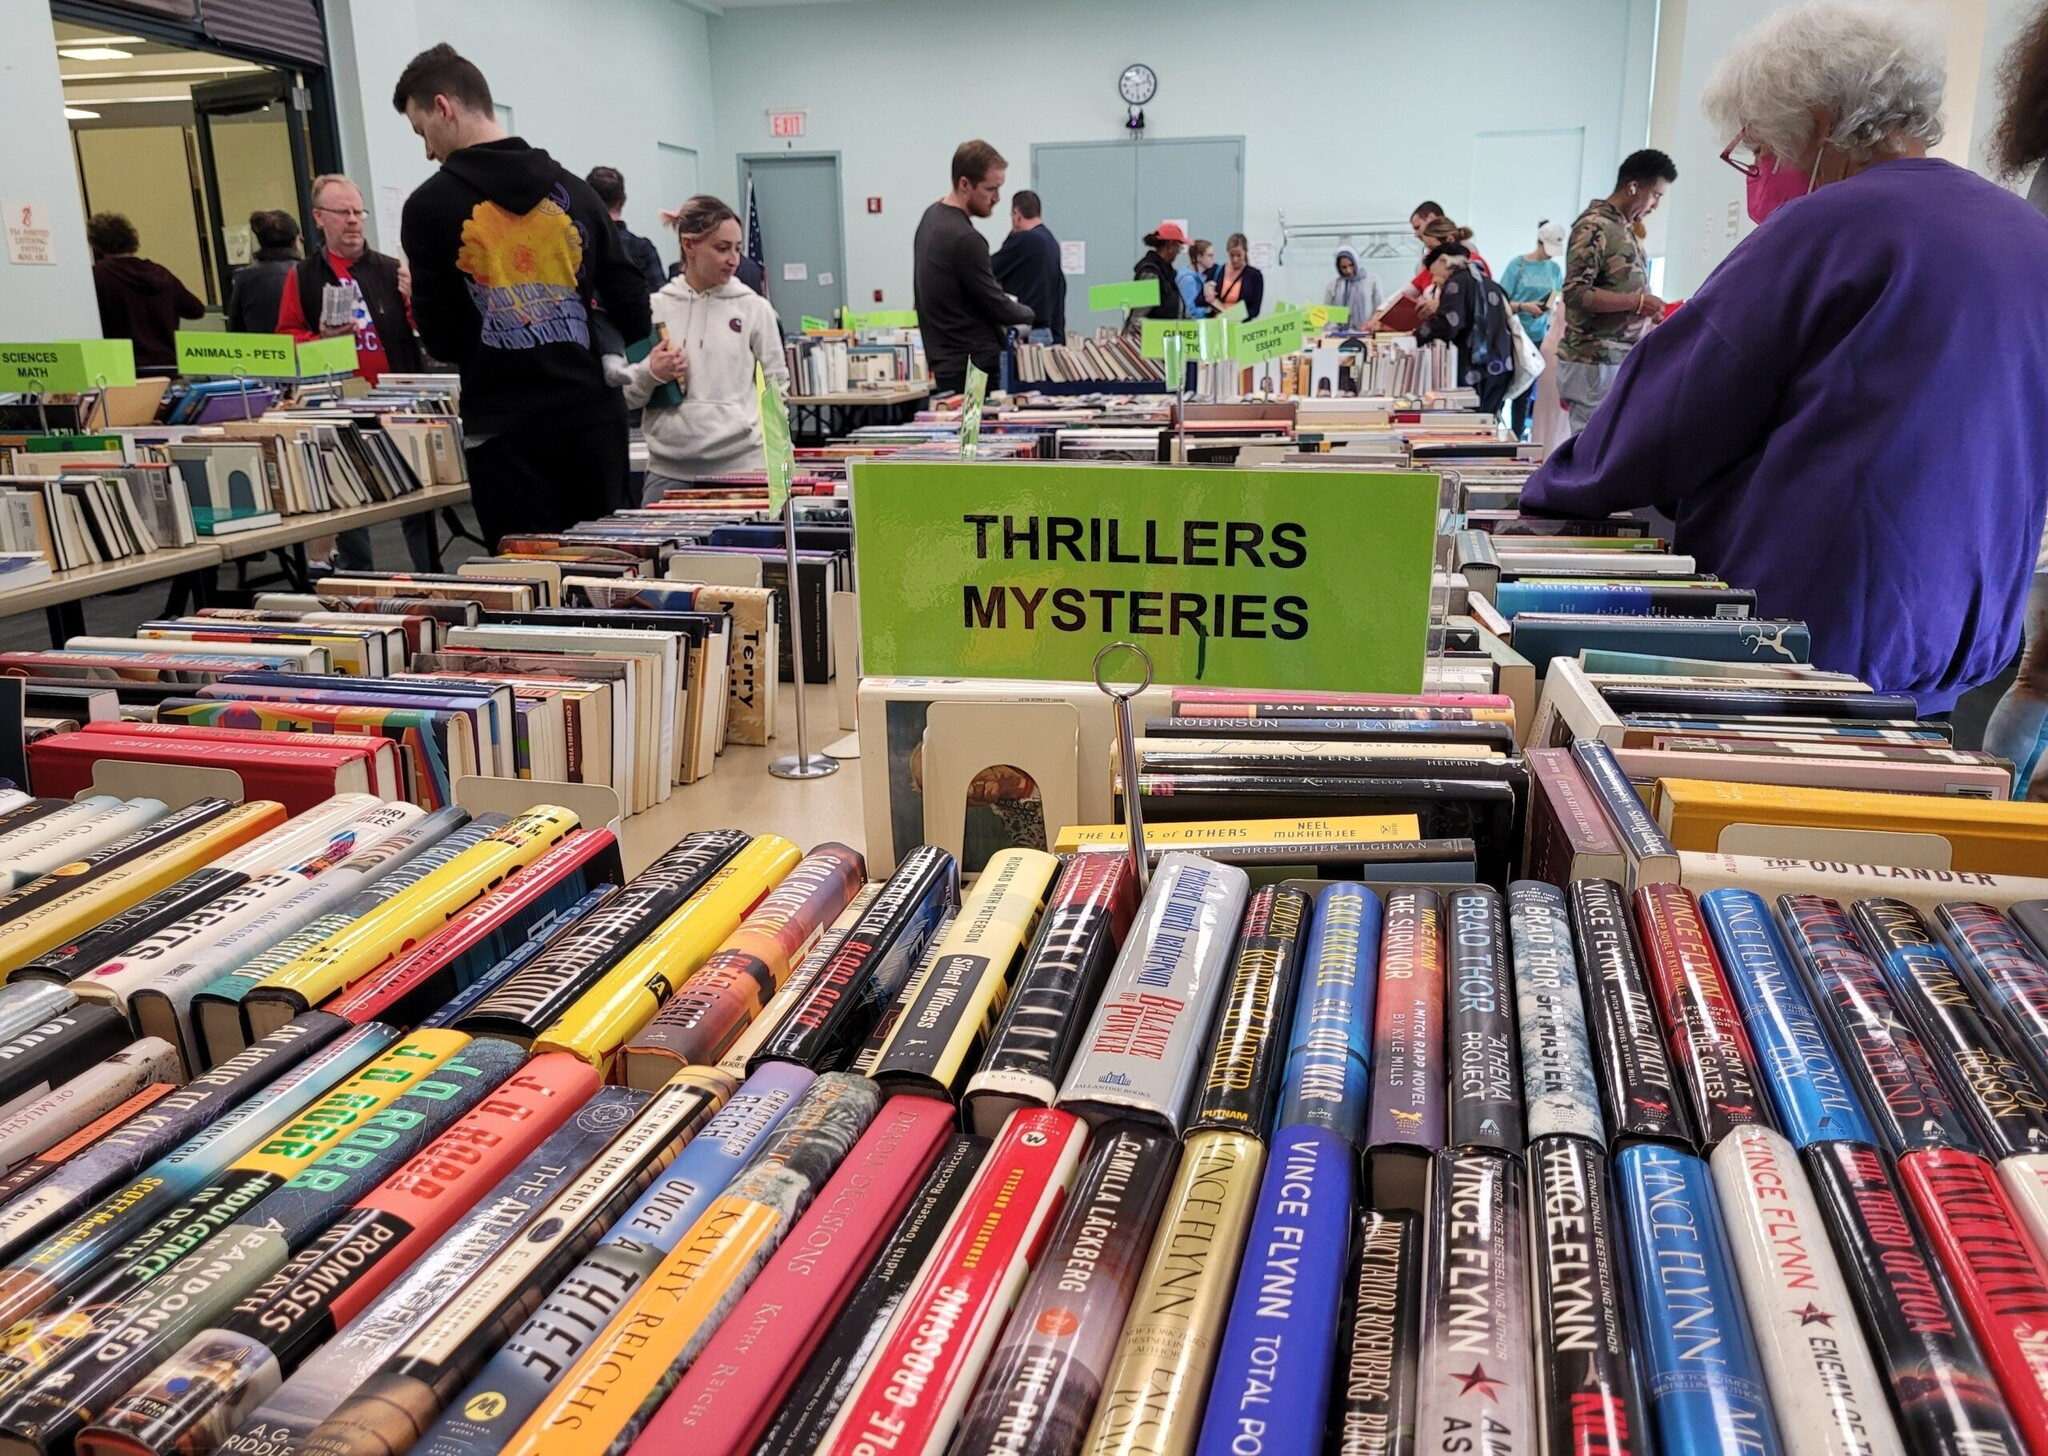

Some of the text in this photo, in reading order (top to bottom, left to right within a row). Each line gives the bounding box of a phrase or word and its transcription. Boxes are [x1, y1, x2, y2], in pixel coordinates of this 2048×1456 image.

[773, 114, 800, 137] EXIT
[2, 352, 58, 363] SCIENCES
[185, 347, 243, 359] ANIMALS
[253, 349, 286, 360] PETS
[1242, 328, 1269, 343] POETRY
[1274, 322, 1295, 335] PLAYS
[1256, 338, 1281, 352] ESSAYS
[17, 367, 48, 378] MATH
[963, 514, 1307, 569] THRILLERS
[963, 585, 1309, 640] MYSTERIES
[1584, 584, 1644, 593] FRAZIER
[741, 630, 759, 708] Terry
[110, 739, 147, 748] RICE
[151, 741, 208, 752] SUSAN
[567, 704, 576, 772] CONTRIBUTIONS
[1170, 718, 1278, 728] ROBINSON
[1325, 721, 1350, 729] OF
[8, 824, 92, 861] GRISHAM
[1077, 828, 1248, 840] THE OTHERS
[1231, 842, 1428, 855] CHRISTOPHER TILGHMAN
[1274, 829, 1357, 839] MUKHERJEE
[1297, 822, 1329, 830] NEEL
[281, 882, 329, 909] RAGNAR
[468, 888, 512, 921] WIFE
[1763, 857, 1801, 872] THE
[1809, 861, 1998, 887] OUTLANDER
[97, 899, 167, 934] NOVEL
[118, 874, 292, 963] RABBITS
[737, 876, 822, 938] PARETSKY
[1385, 894, 1415, 981] THE SURVIVOR
[1584, 884, 1627, 980] VINCE FLYNN
[1721, 895, 1764, 940] VINCE
[1456, 896, 1495, 1014] BRAD THOR
[1525, 905, 1562, 990] BRAD THOR
[1660, 930, 1687, 997] NOVEL MILLS
[1665, 893, 1723, 999] VINCE FLYNN
[798, 941, 873, 1030] BLOOD OATH
[916, 956, 975, 1030] Silent Witness
[1300, 893, 1363, 1103] SEAN PARNELL WAR
[889, 1051, 935, 1060] KNOPF
[1094, 1003, 1146, 1055] POWER
[1129, 992, 1185, 1061] BALANCE
[1390, 1027, 1406, 1087] KYLE MILLS
[1412, 1008, 1426, 1106] MITCH RAPP NOVEL
[1618, 1025, 1637, 1087] NOVEL MILLS
[1718, 1033, 1747, 1075] ENEMY
[55, 1089, 74, 1102] OF
[92, 1024, 309, 1147] AN HOUR TO KILL
[1074, 1083, 1152, 1099] BALLANTINE BOOKS
[1461, 1031, 1486, 1101] PROJECT
[1486, 1036, 1514, 1102] ATHENA
[1635, 1033, 1671, 1091] LOYALTY
[1699, 1057, 1728, 1099] GATES
[1786, 1020, 1853, 1112] MEMORIAL
[259, 1093, 380, 1160] ROBB
[699, 1094, 763, 1140] REICH
[721, 1089, 791, 1158] CHRISTOPHER
[1202, 1108, 1249, 1121] PUTNAM
[284, 1108, 428, 1193] ROBB
[385, 1125, 503, 1200] ROBB
[521, 1164, 567, 1199] THE
[559, 1098, 686, 1213] THIS NEVER HAPPENED
[104, 1177, 164, 1213] SCOTT
[115, 1186, 225, 1259] IN DEATH
[878, 1139, 973, 1285] Judith Townsend Rocchiccioli
[961, 1167, 1026, 1271] SEBASTIAN ROTELLA
[1057, 1141, 1143, 1295] CAMILLA LÄCKBERG
[1543, 1149, 1587, 1236] VINCE
[1641, 1158, 1698, 1242] VINCE
[1740, 1136, 1820, 1292] VINCE FLYNN
[125, 1178, 273, 1281] INDULGENCE
[1150, 1141, 1240, 1322] VINCE FLYNN
[1448, 1157, 1490, 1356] VINCE FLYNN
[95, 1217, 286, 1363] ABANDONED
[233, 1247, 324, 1314] DEATH
[259, 1222, 395, 1335] PROMISES
[506, 1179, 697, 1385] ONCE A THIEF
[1240, 1141, 1320, 1411] VINCE FLYNN TOTAL
[1493, 1174, 1508, 1362] YORK TIMES BESTSELLING AUTHOR
[1550, 1241, 1598, 1351] FLYNN
[1594, 1234, 1618, 1355] BESTSELLING AUTHOR
[1854, 1189, 1957, 1339] THIRD OPTION
[552, 1208, 745, 1432] KATHY REICHS
[682, 1172, 871, 1428] DECISIONS KATHY REICHS
[1657, 1249, 1727, 1367] FLYNN
[883, 1284, 971, 1410] CROSSING
[1347, 1314, 1396, 1402] ROSENBERG
[222, 1434, 295, 1456] RIDDLE
[248, 1424, 290, 1443] A.G.
